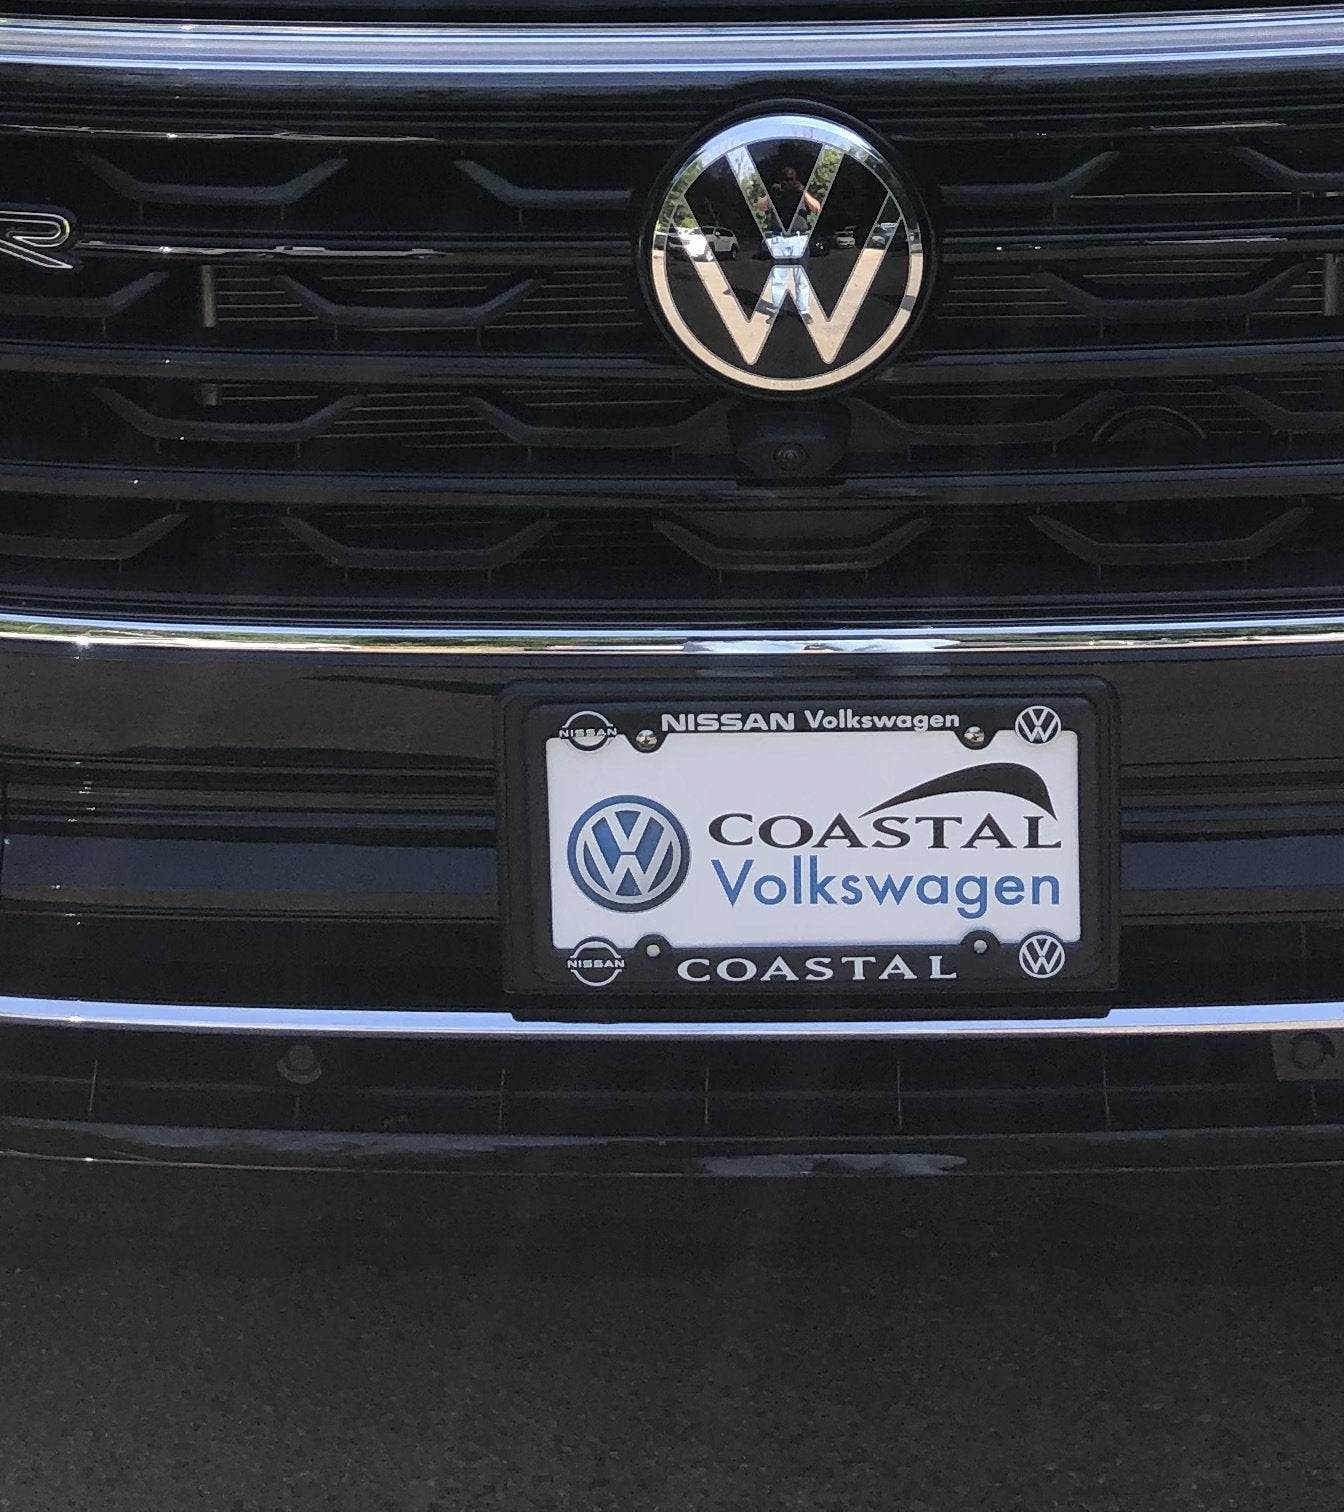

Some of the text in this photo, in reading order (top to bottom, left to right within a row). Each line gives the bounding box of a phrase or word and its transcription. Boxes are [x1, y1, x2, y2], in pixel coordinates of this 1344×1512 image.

[558, 727, 618, 738] NISSAN
[661, 709, 961, 732] NISSAN Volkswagen
[708, 812, 1062, 850] COASTAL
[710, 854, 1061, 919] Volkswagen
[567, 959, 625, 969] NISSAN
[677, 953, 959, 982] COASTAL
